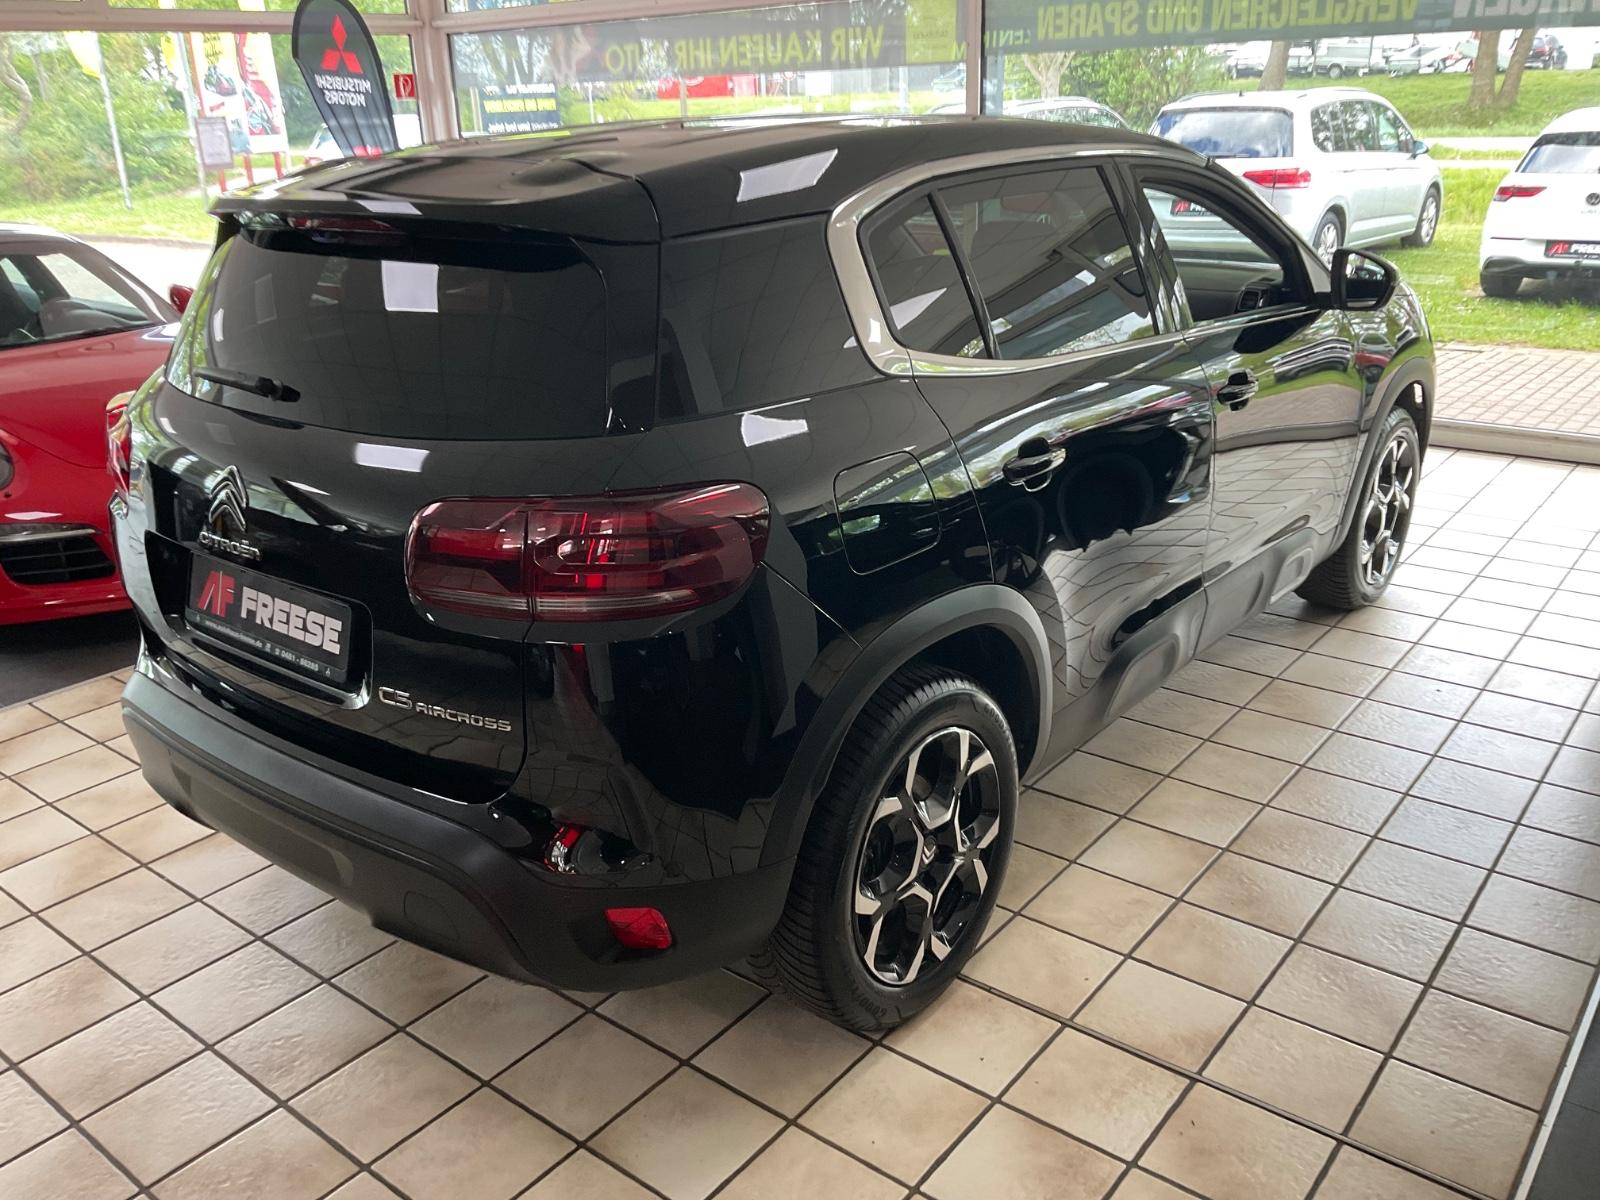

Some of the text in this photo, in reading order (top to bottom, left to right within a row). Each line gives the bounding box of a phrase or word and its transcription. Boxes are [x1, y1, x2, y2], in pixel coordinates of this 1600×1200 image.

[240, 586, 343, 656] FREESE
[378, 686, 512, 732] C5 AIRCROSS
